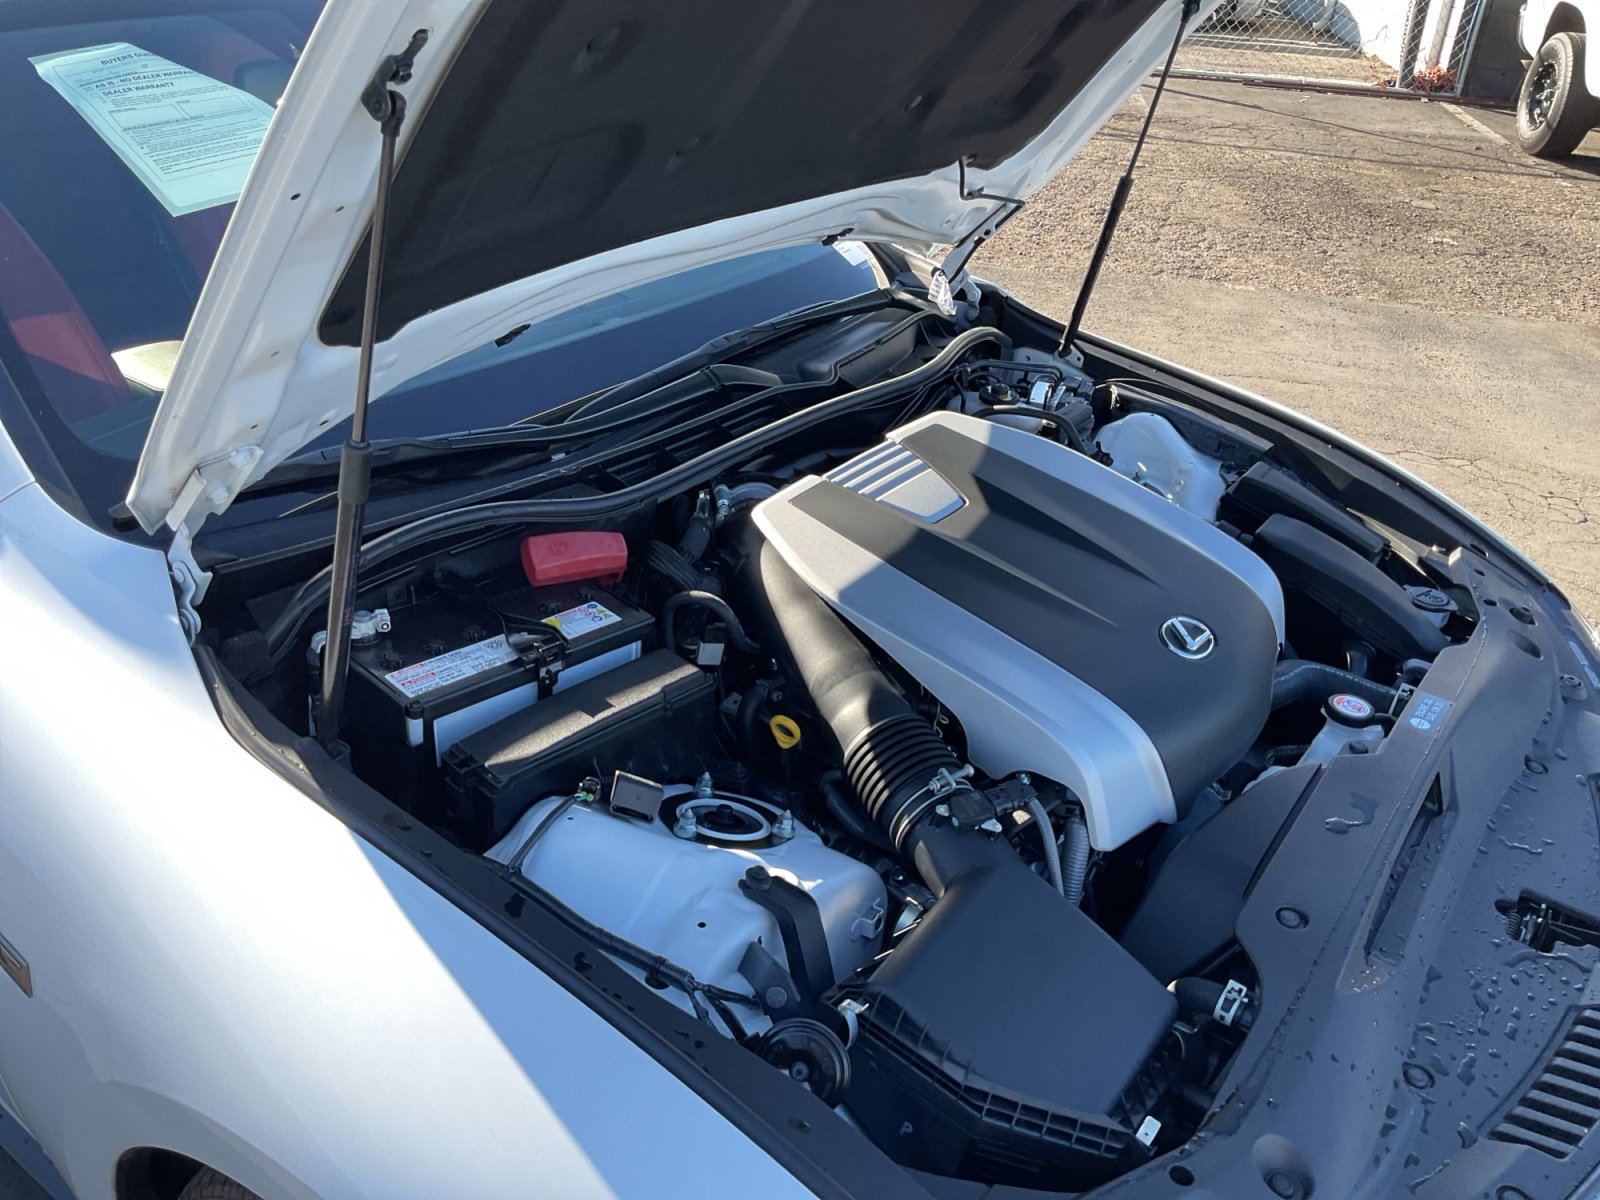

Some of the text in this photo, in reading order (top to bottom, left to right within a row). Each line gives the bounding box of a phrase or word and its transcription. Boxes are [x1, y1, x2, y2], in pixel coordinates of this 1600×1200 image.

[100, 54, 134, 66] BUYERS
[132, 73, 161, 81] DEALER
[102, 81, 175, 96] DEALER WARRANTY
